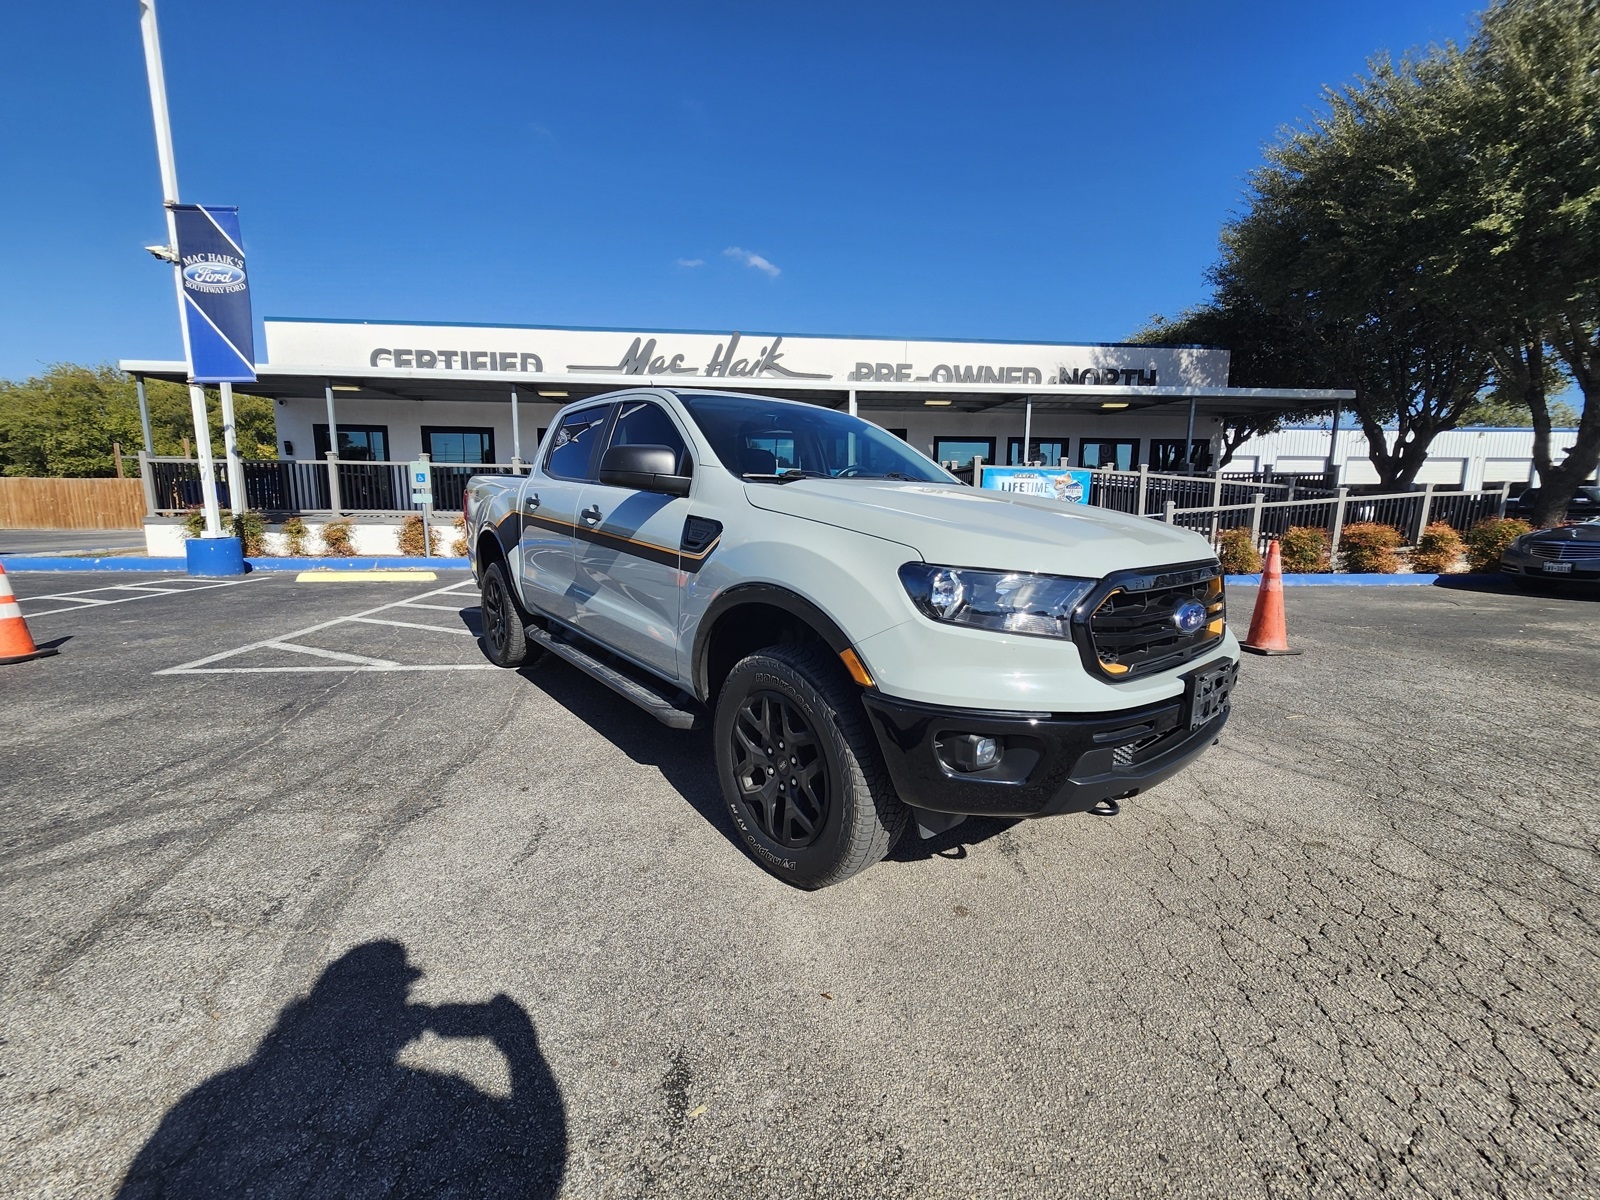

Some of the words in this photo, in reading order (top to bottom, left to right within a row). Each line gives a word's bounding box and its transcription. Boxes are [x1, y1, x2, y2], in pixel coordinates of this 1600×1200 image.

[182, 253, 205, 267] MAC
[207, 253, 244, 269] HAIK'S
[194, 265, 233, 283] Ford
[184, 280, 225, 294] SOUTHWAY
[226, 283, 246, 294] FORD
[369, 347, 544, 373] CERTIFIED
[566, 336, 699, 376] Mac
[705, 331, 833, 379] Haik
[855, 362, 1042, 384] PRE-OWNED
[1058, 367, 1157, 387] NORTH
[1001, 481, 1050, 494] LIFETIME
